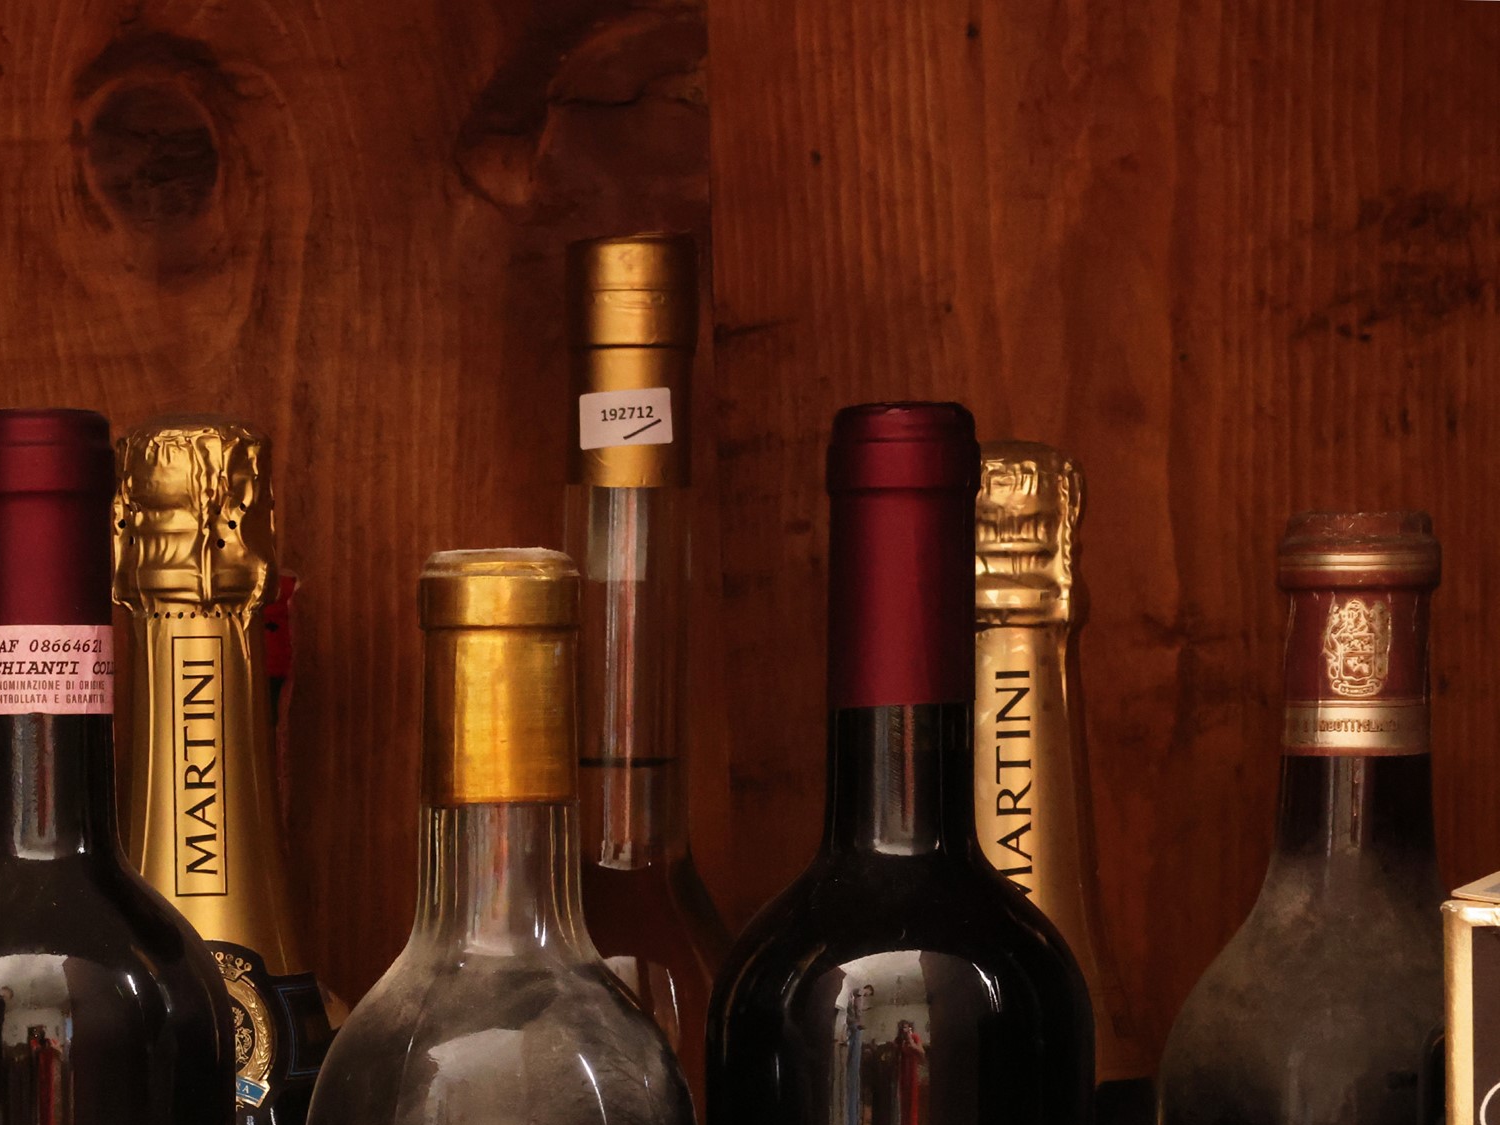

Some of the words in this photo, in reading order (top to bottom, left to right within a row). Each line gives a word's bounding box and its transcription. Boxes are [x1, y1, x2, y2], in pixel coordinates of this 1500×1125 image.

[600, 404, 655, 423] 192712
[65, 680, 75, 691] DI
[182, 657, 219, 877] MARTINI
